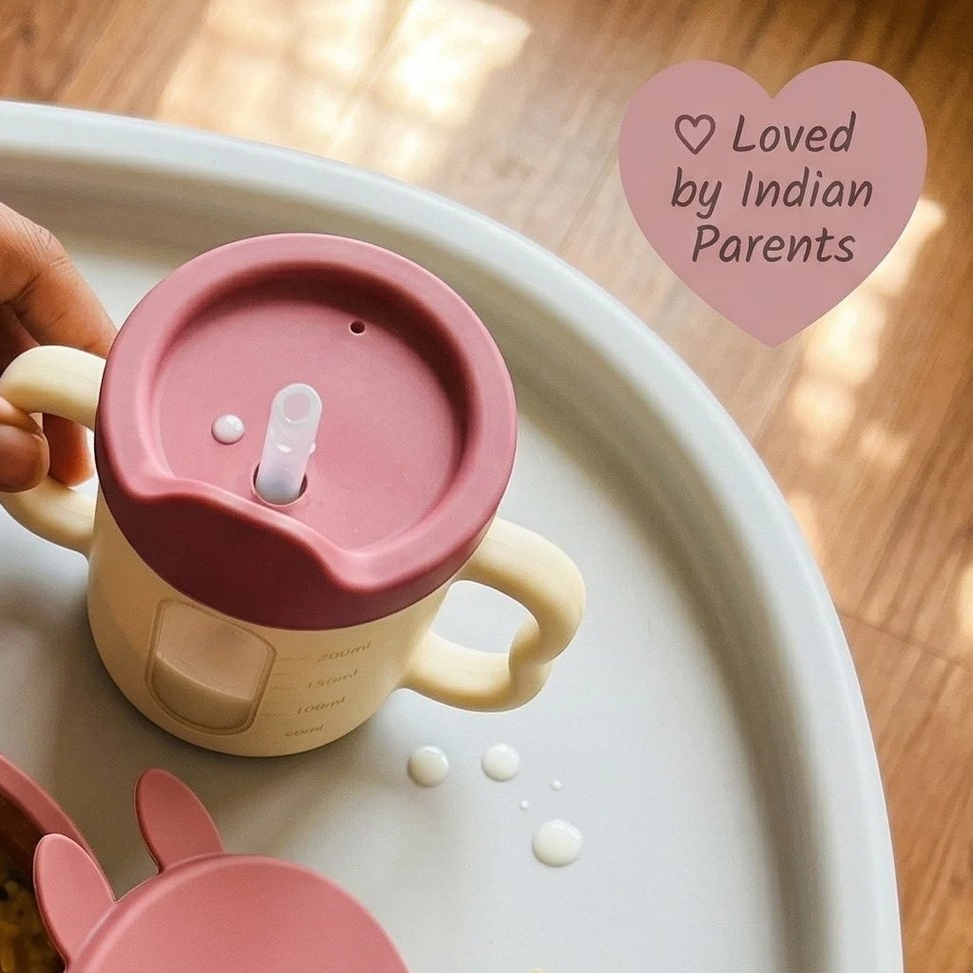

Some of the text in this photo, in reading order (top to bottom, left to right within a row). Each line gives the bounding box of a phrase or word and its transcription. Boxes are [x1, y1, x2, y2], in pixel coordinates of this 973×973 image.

[317, 640, 372, 663] 200ml
[307, 669, 359, 689] 150ml
[297, 696, 346, 715] 100ml
